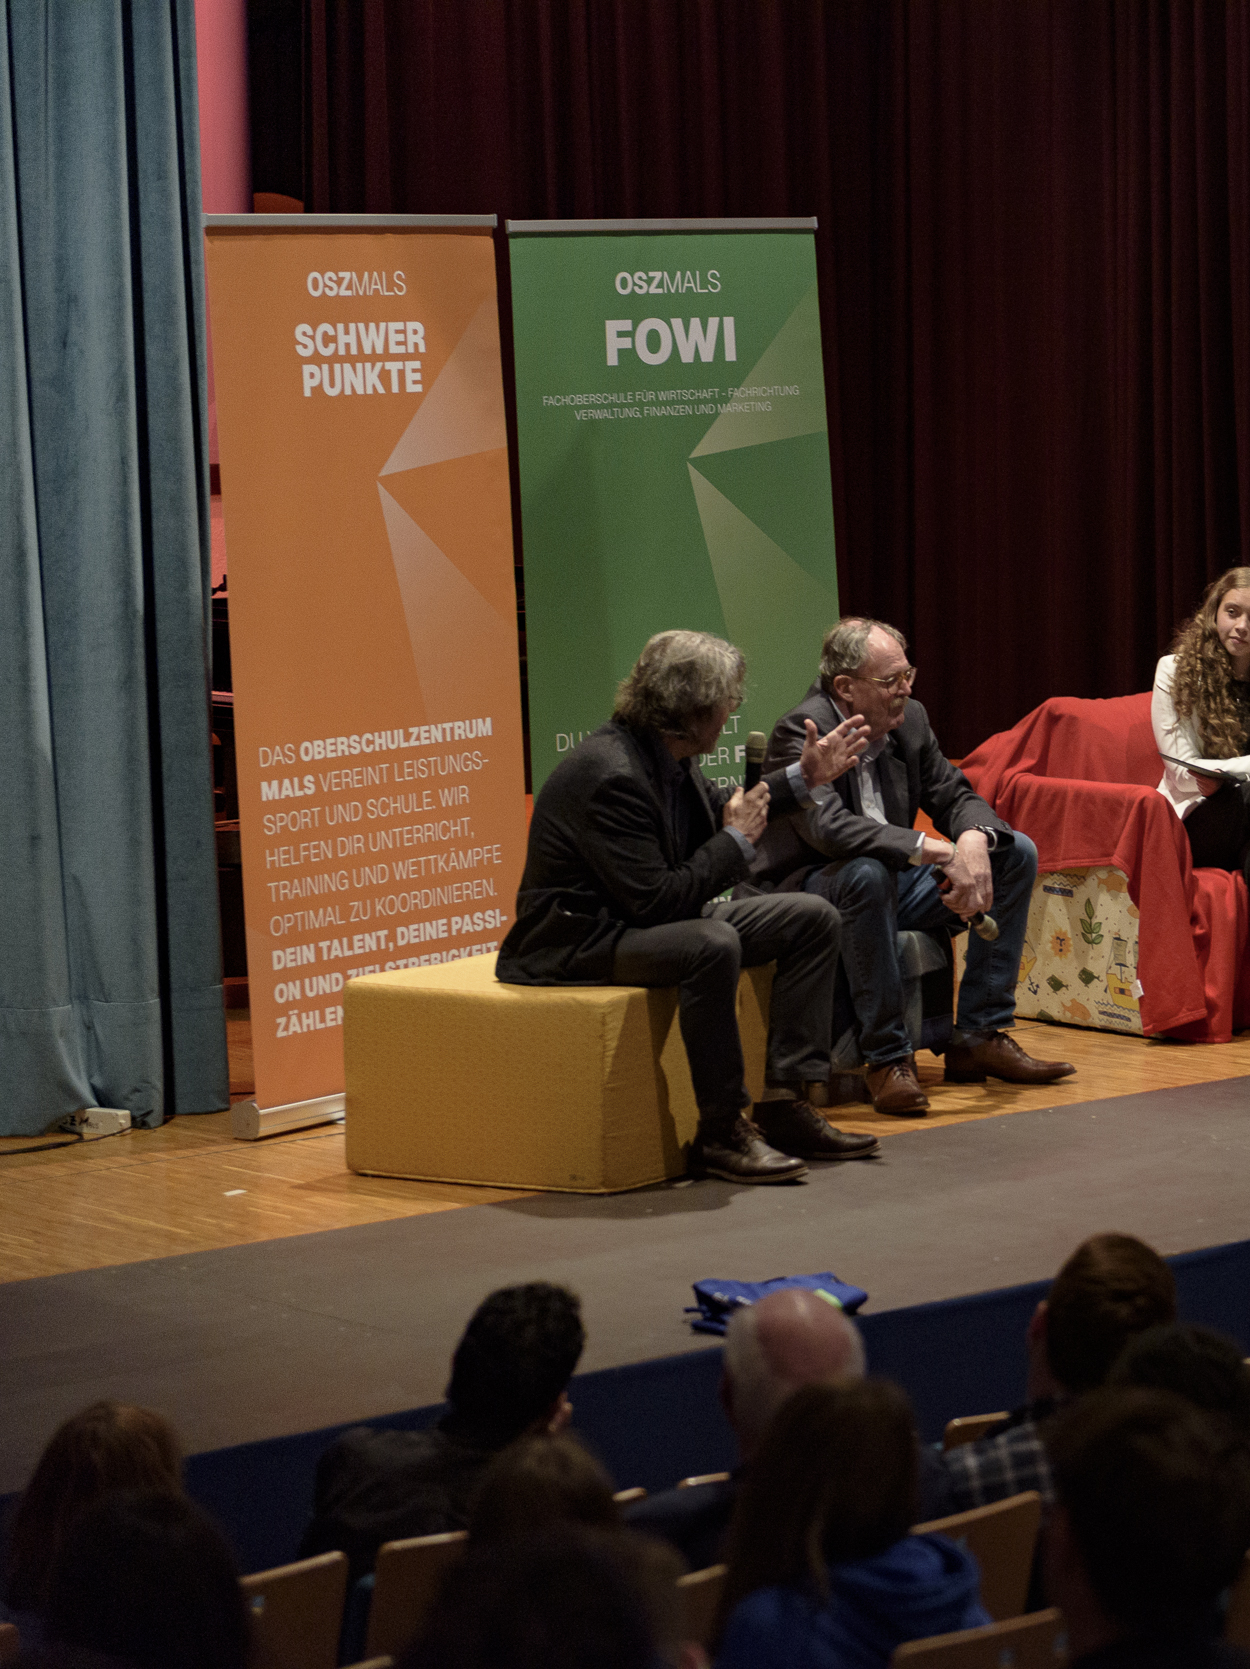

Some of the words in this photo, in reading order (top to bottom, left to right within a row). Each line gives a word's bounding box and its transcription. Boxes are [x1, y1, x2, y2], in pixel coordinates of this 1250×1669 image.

[307, 270, 407, 297] OSZMALS
[614, 270, 722, 296] OSZMALS
[294, 321, 426, 358] SCHWER
[605, 316, 738, 366] FOWI
[301, 360, 424, 397] PUNKTE
[542, 391, 634, 406] FACHOBERSCHULE
[635, 389, 656, 402] FÜR
[657, 388, 719, 402] WIRTSCHAFT
[728, 385, 800, 399] FACHRICHTUNG
[574, 406, 642, 421] VERWALTUNG,
[643, 404, 693, 418] FINANZEN
[695, 403, 716, 415] UND
[718, 401, 772, 414] MARKETING
[258, 743, 297, 768] DAS
[299, 717, 493, 762] OBERSCHULZENTRUM
[260, 774, 316, 802] MALS
[319, 763, 390, 792] VEREINT
[394, 750, 490, 782] LEISTUNGS-
[263, 807, 321, 836] SPORT
[325, 801, 363, 826] UND
[366, 790, 437, 820] SCHULE.
[439, 785, 470, 808] WIR
[265, 839, 333, 869] HELFEN
[337, 834, 366, 857] DIR
[369, 817, 475, 852] UNTERRICHT,
[266, 870, 349, 902] TRAINING
[352, 863, 389, 888] UND
[392, 844, 502, 879] WETTKÄMPFE
[269, 905, 346, 937] OPTIMAL
[349, 899, 371, 922] ZU
[375, 878, 498, 917] KOORDINIEREN.
[272, 943, 316, 971] DEIN
[318, 929, 394, 960] TALENT,
[396, 918, 449, 946] DEINE
[451, 908, 508, 935] PASSI-
[274, 979, 301, 1004] ON
[304, 972, 344, 998] UND
